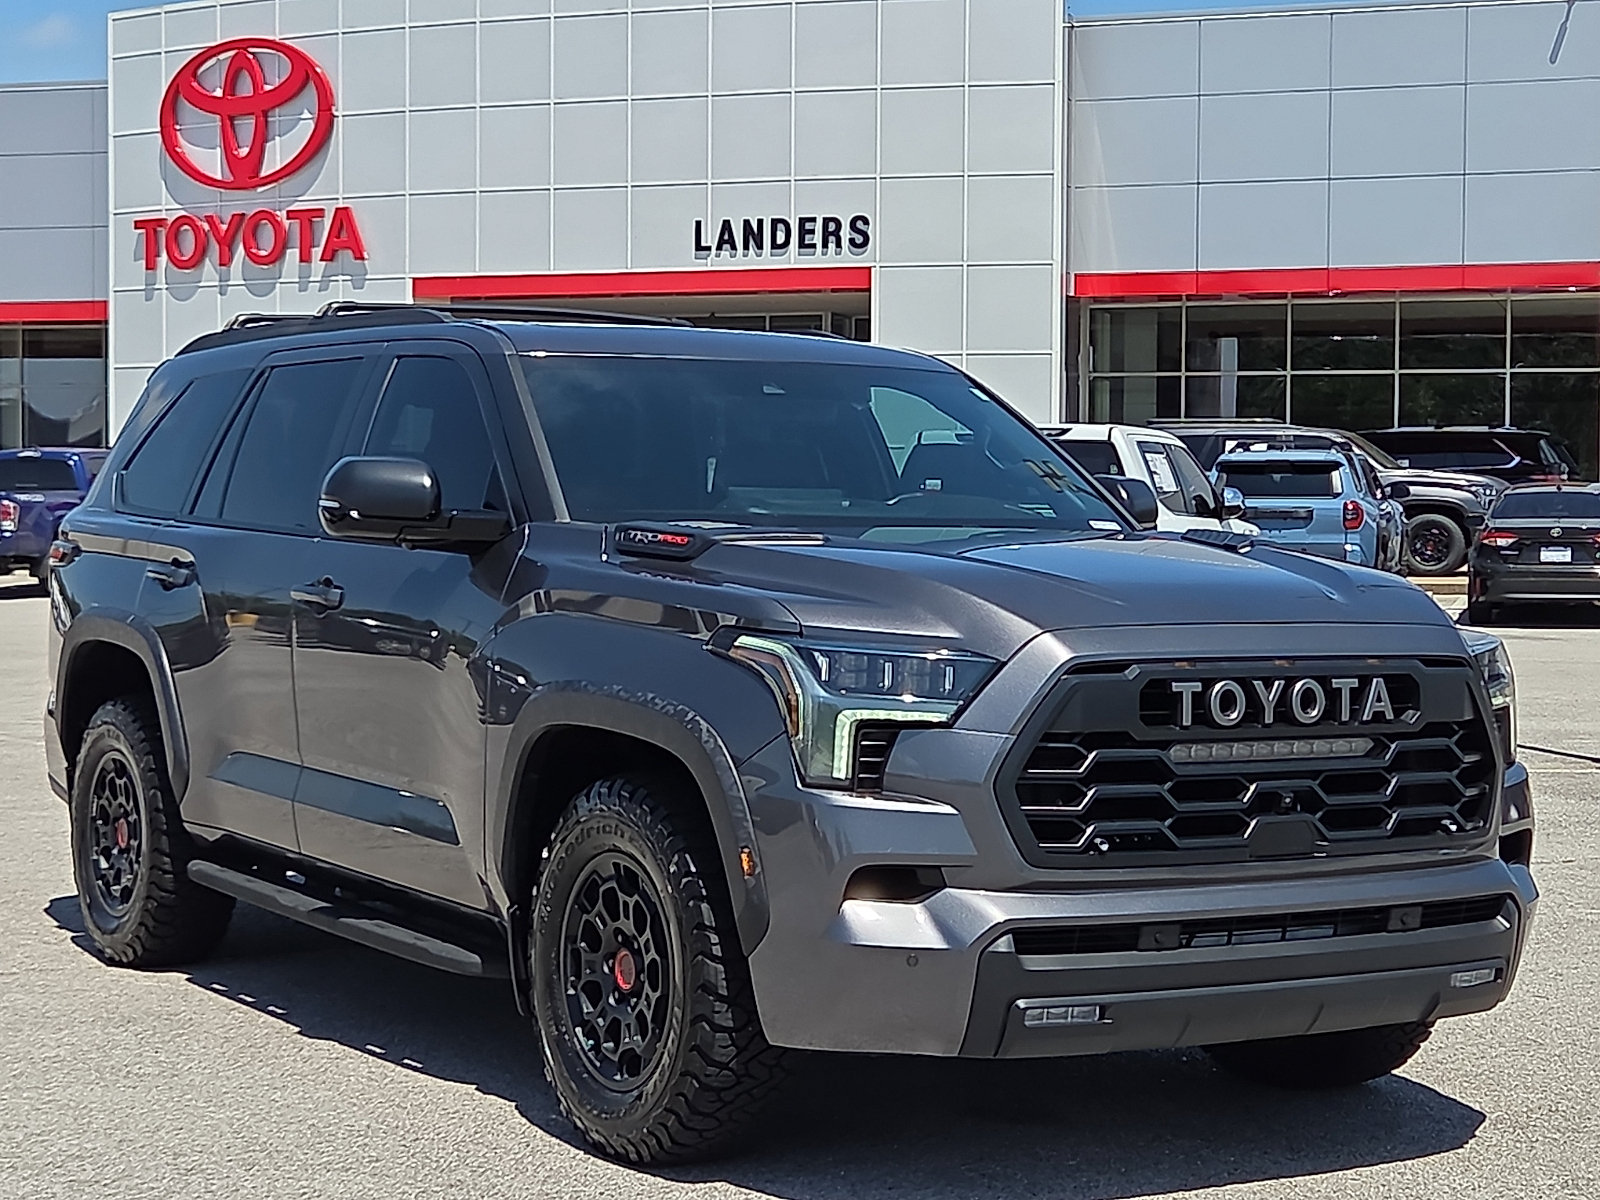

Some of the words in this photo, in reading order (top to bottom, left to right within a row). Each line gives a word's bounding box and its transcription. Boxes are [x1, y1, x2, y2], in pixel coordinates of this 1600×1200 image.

[134, 206, 366, 270] TOYOTA
[694, 215, 870, 252] LANDERS
[628, 530, 660, 543] TRD
[1172, 677, 1394, 726] TOYOTA
